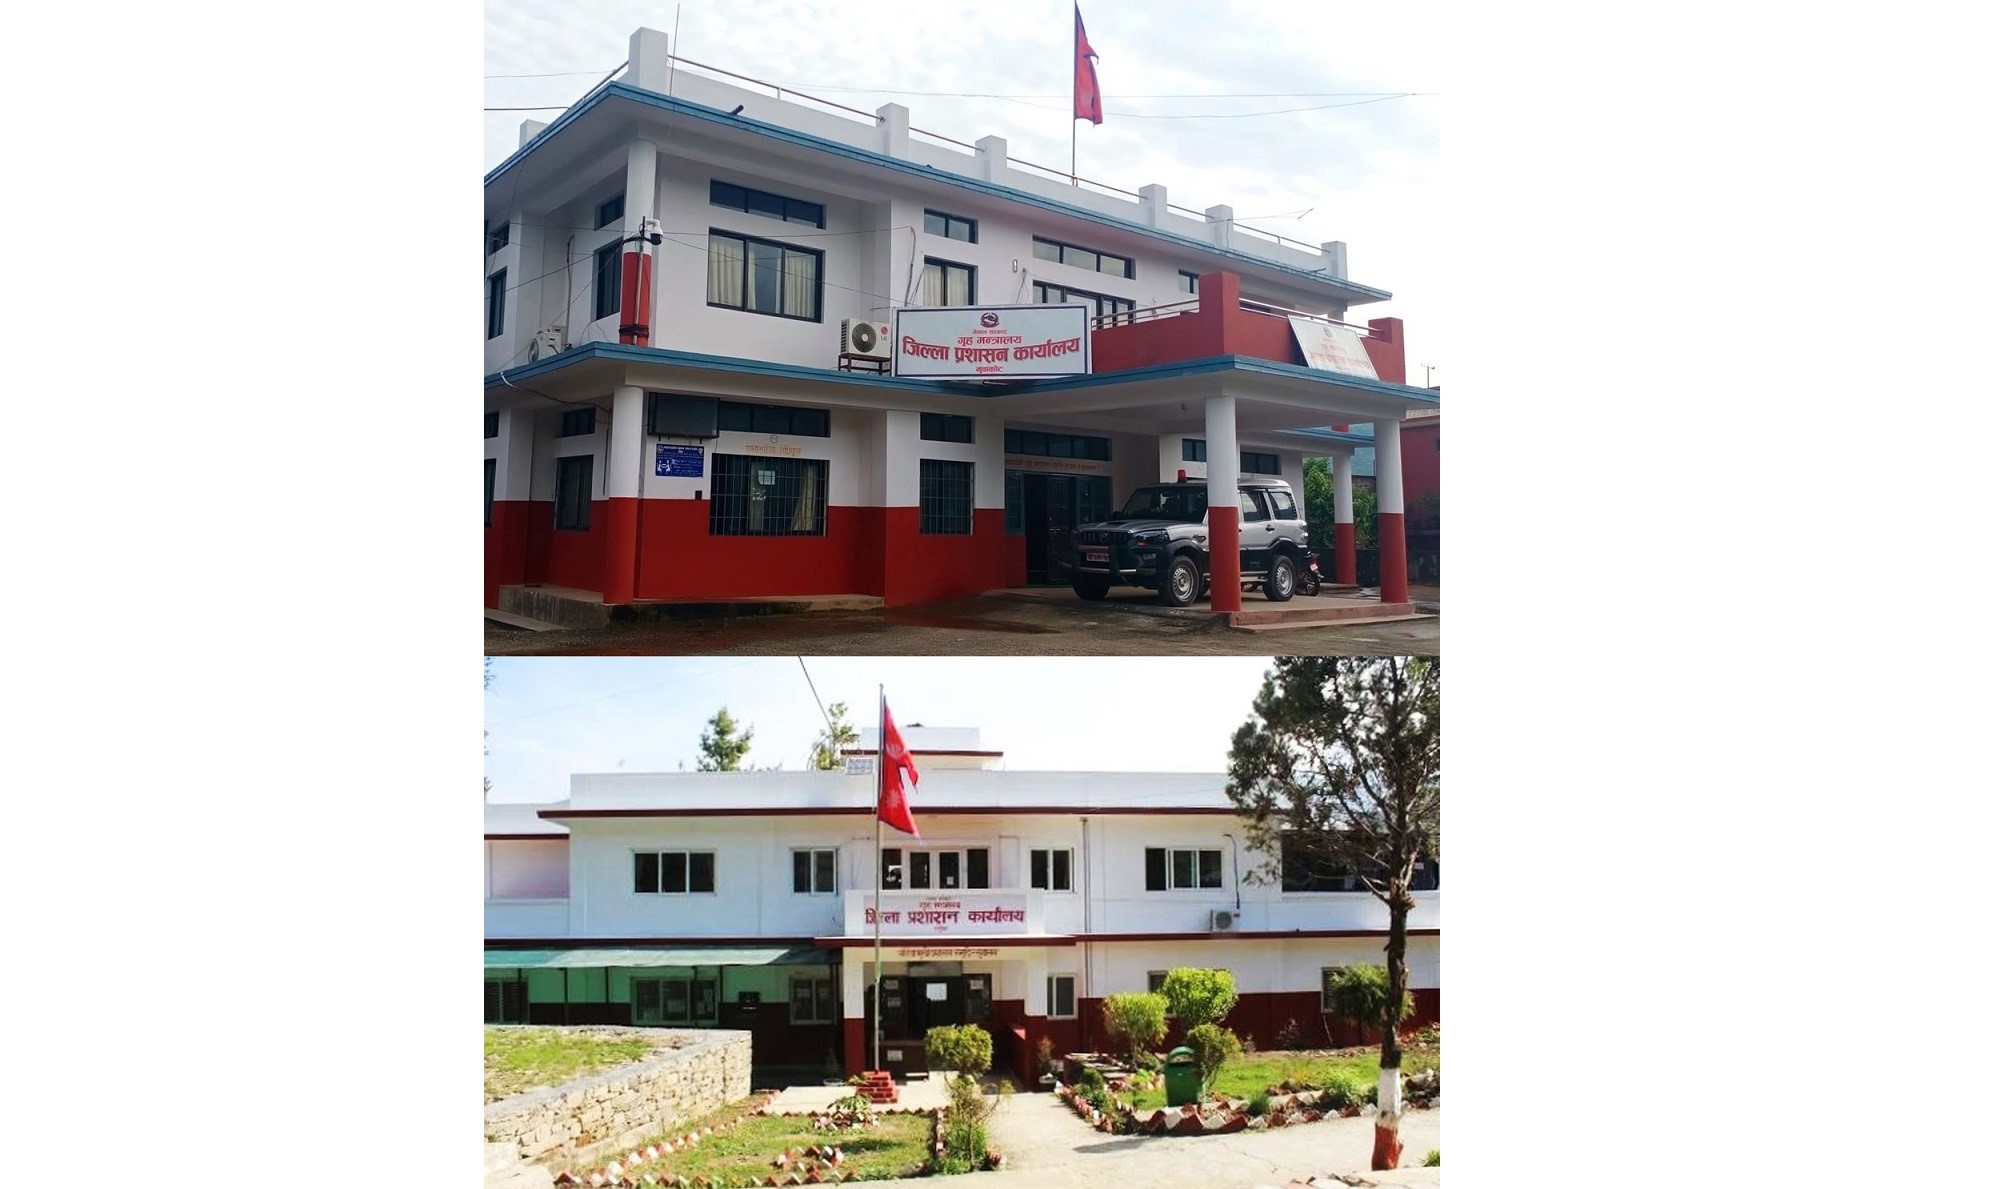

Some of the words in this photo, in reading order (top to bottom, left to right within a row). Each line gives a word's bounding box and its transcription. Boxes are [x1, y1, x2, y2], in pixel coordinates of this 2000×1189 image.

[957, 336, 974, 347] गृह
[976, 335, 1023, 345] मन्त्रालय
[902, 335, 950, 361] जिल्ला
[954, 347, 1009, 364] प्रशासन
[1013, 337, 1081, 361] कार्यालय
[968, 907, 1025, 923] कार्यालय
